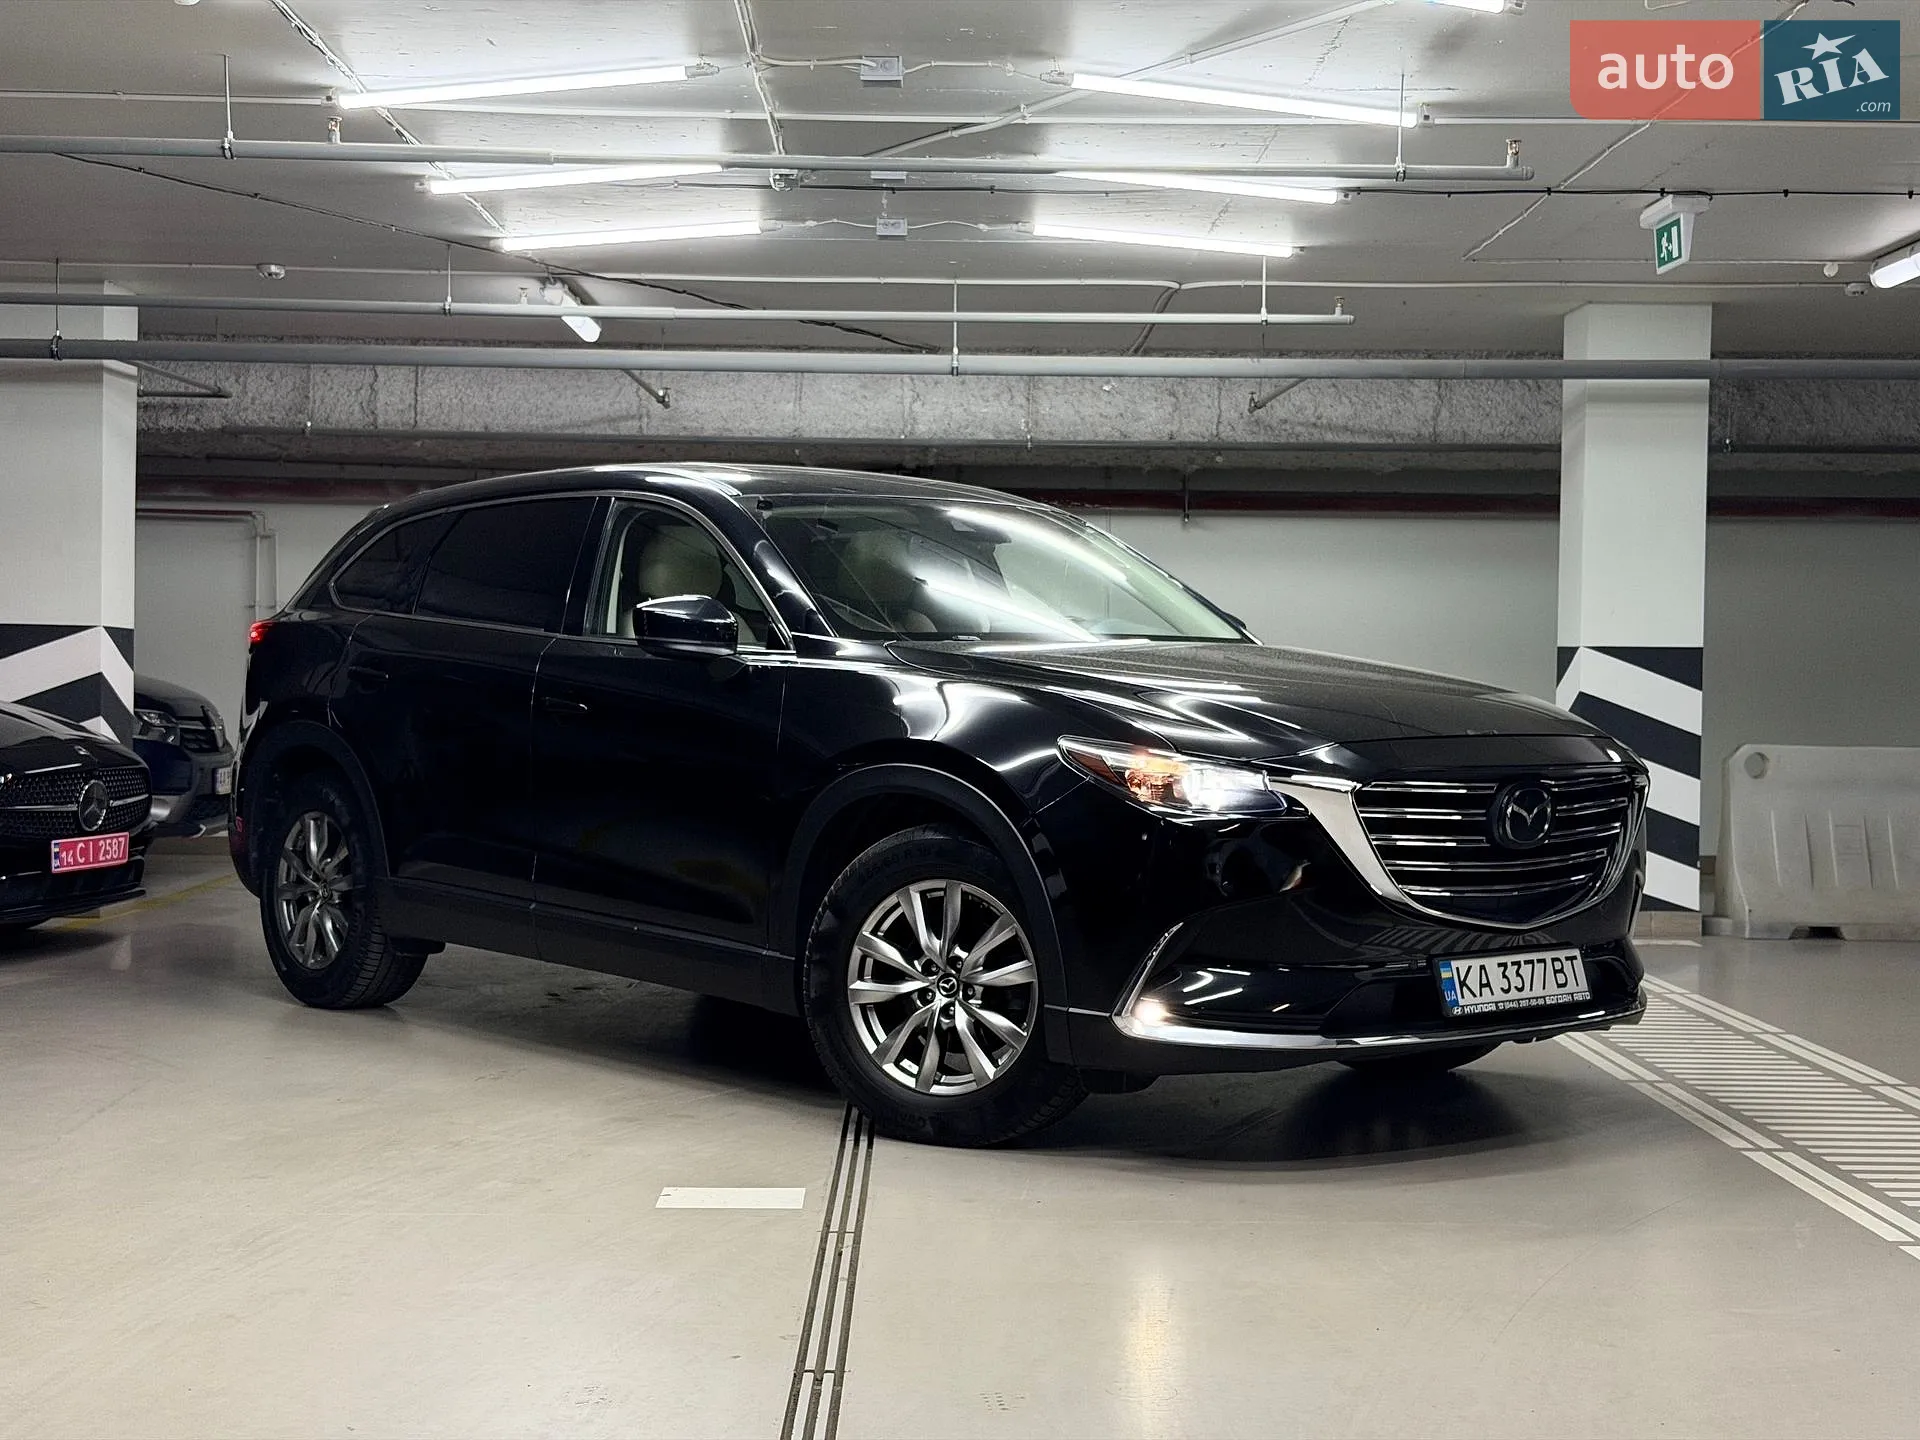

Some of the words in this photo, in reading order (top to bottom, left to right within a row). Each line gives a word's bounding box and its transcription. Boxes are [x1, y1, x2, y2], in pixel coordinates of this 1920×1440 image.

[61, 850, 74, 866] 14
[98, 837, 125, 861] 2587
[1455, 964, 1494, 999] KA
[1497, 958, 1547, 994] 3377
[1551, 955, 1579, 988] BT
[1444, 991, 1457, 1001] UA
[1464, 1003, 1496, 1014] HYUNDAI
